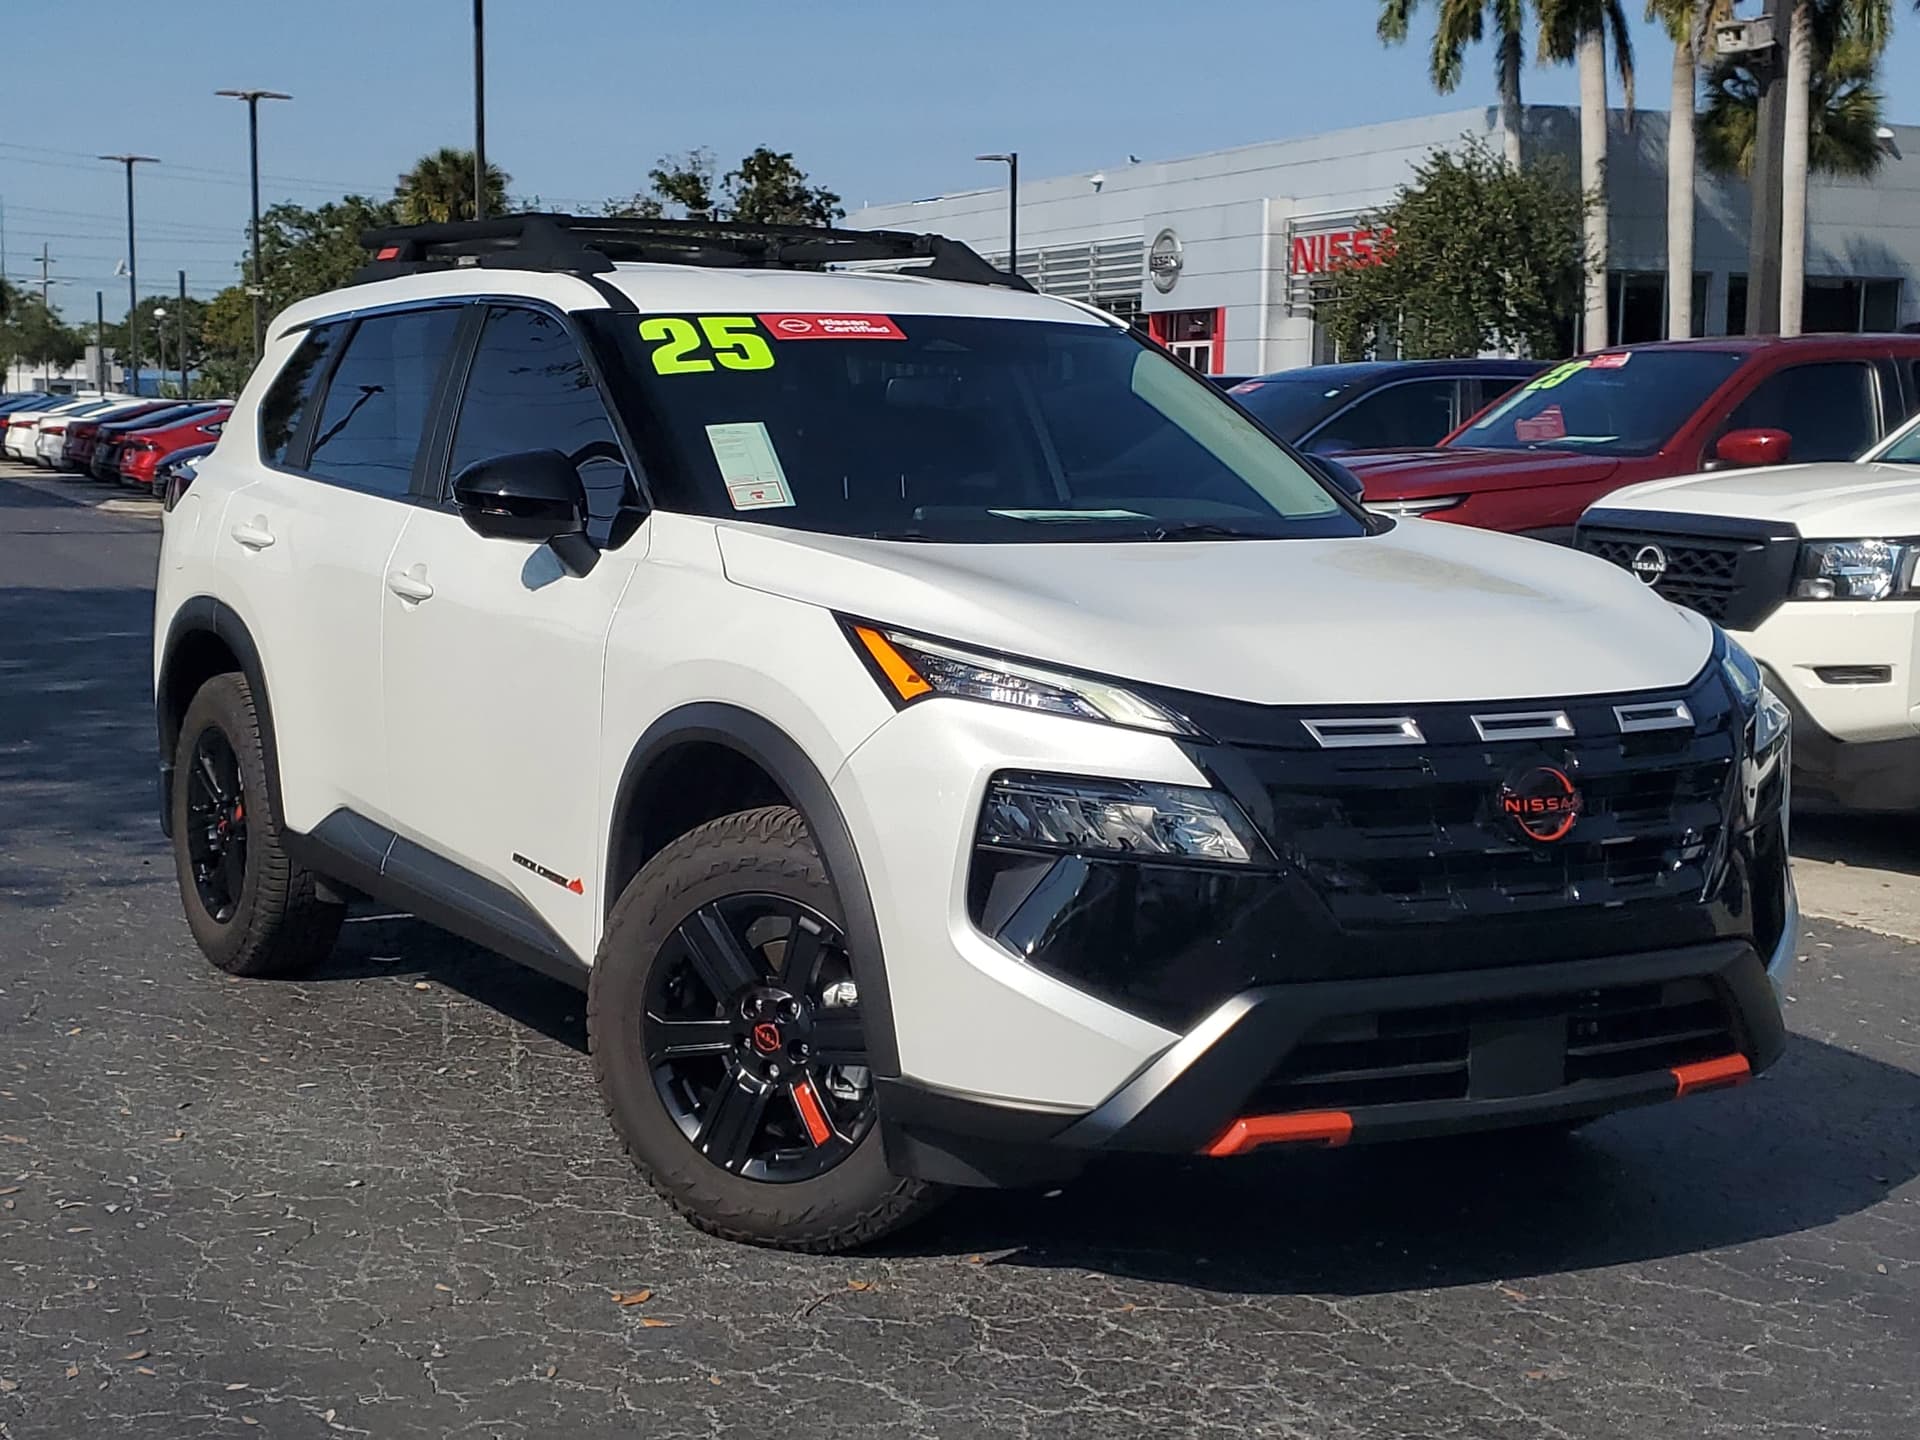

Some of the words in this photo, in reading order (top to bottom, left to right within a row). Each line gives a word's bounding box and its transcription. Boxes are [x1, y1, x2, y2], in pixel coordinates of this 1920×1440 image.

[817, 318, 871, 326] Nissan
[823, 326, 891, 334] Certified
[638, 317, 775, 375] 25
